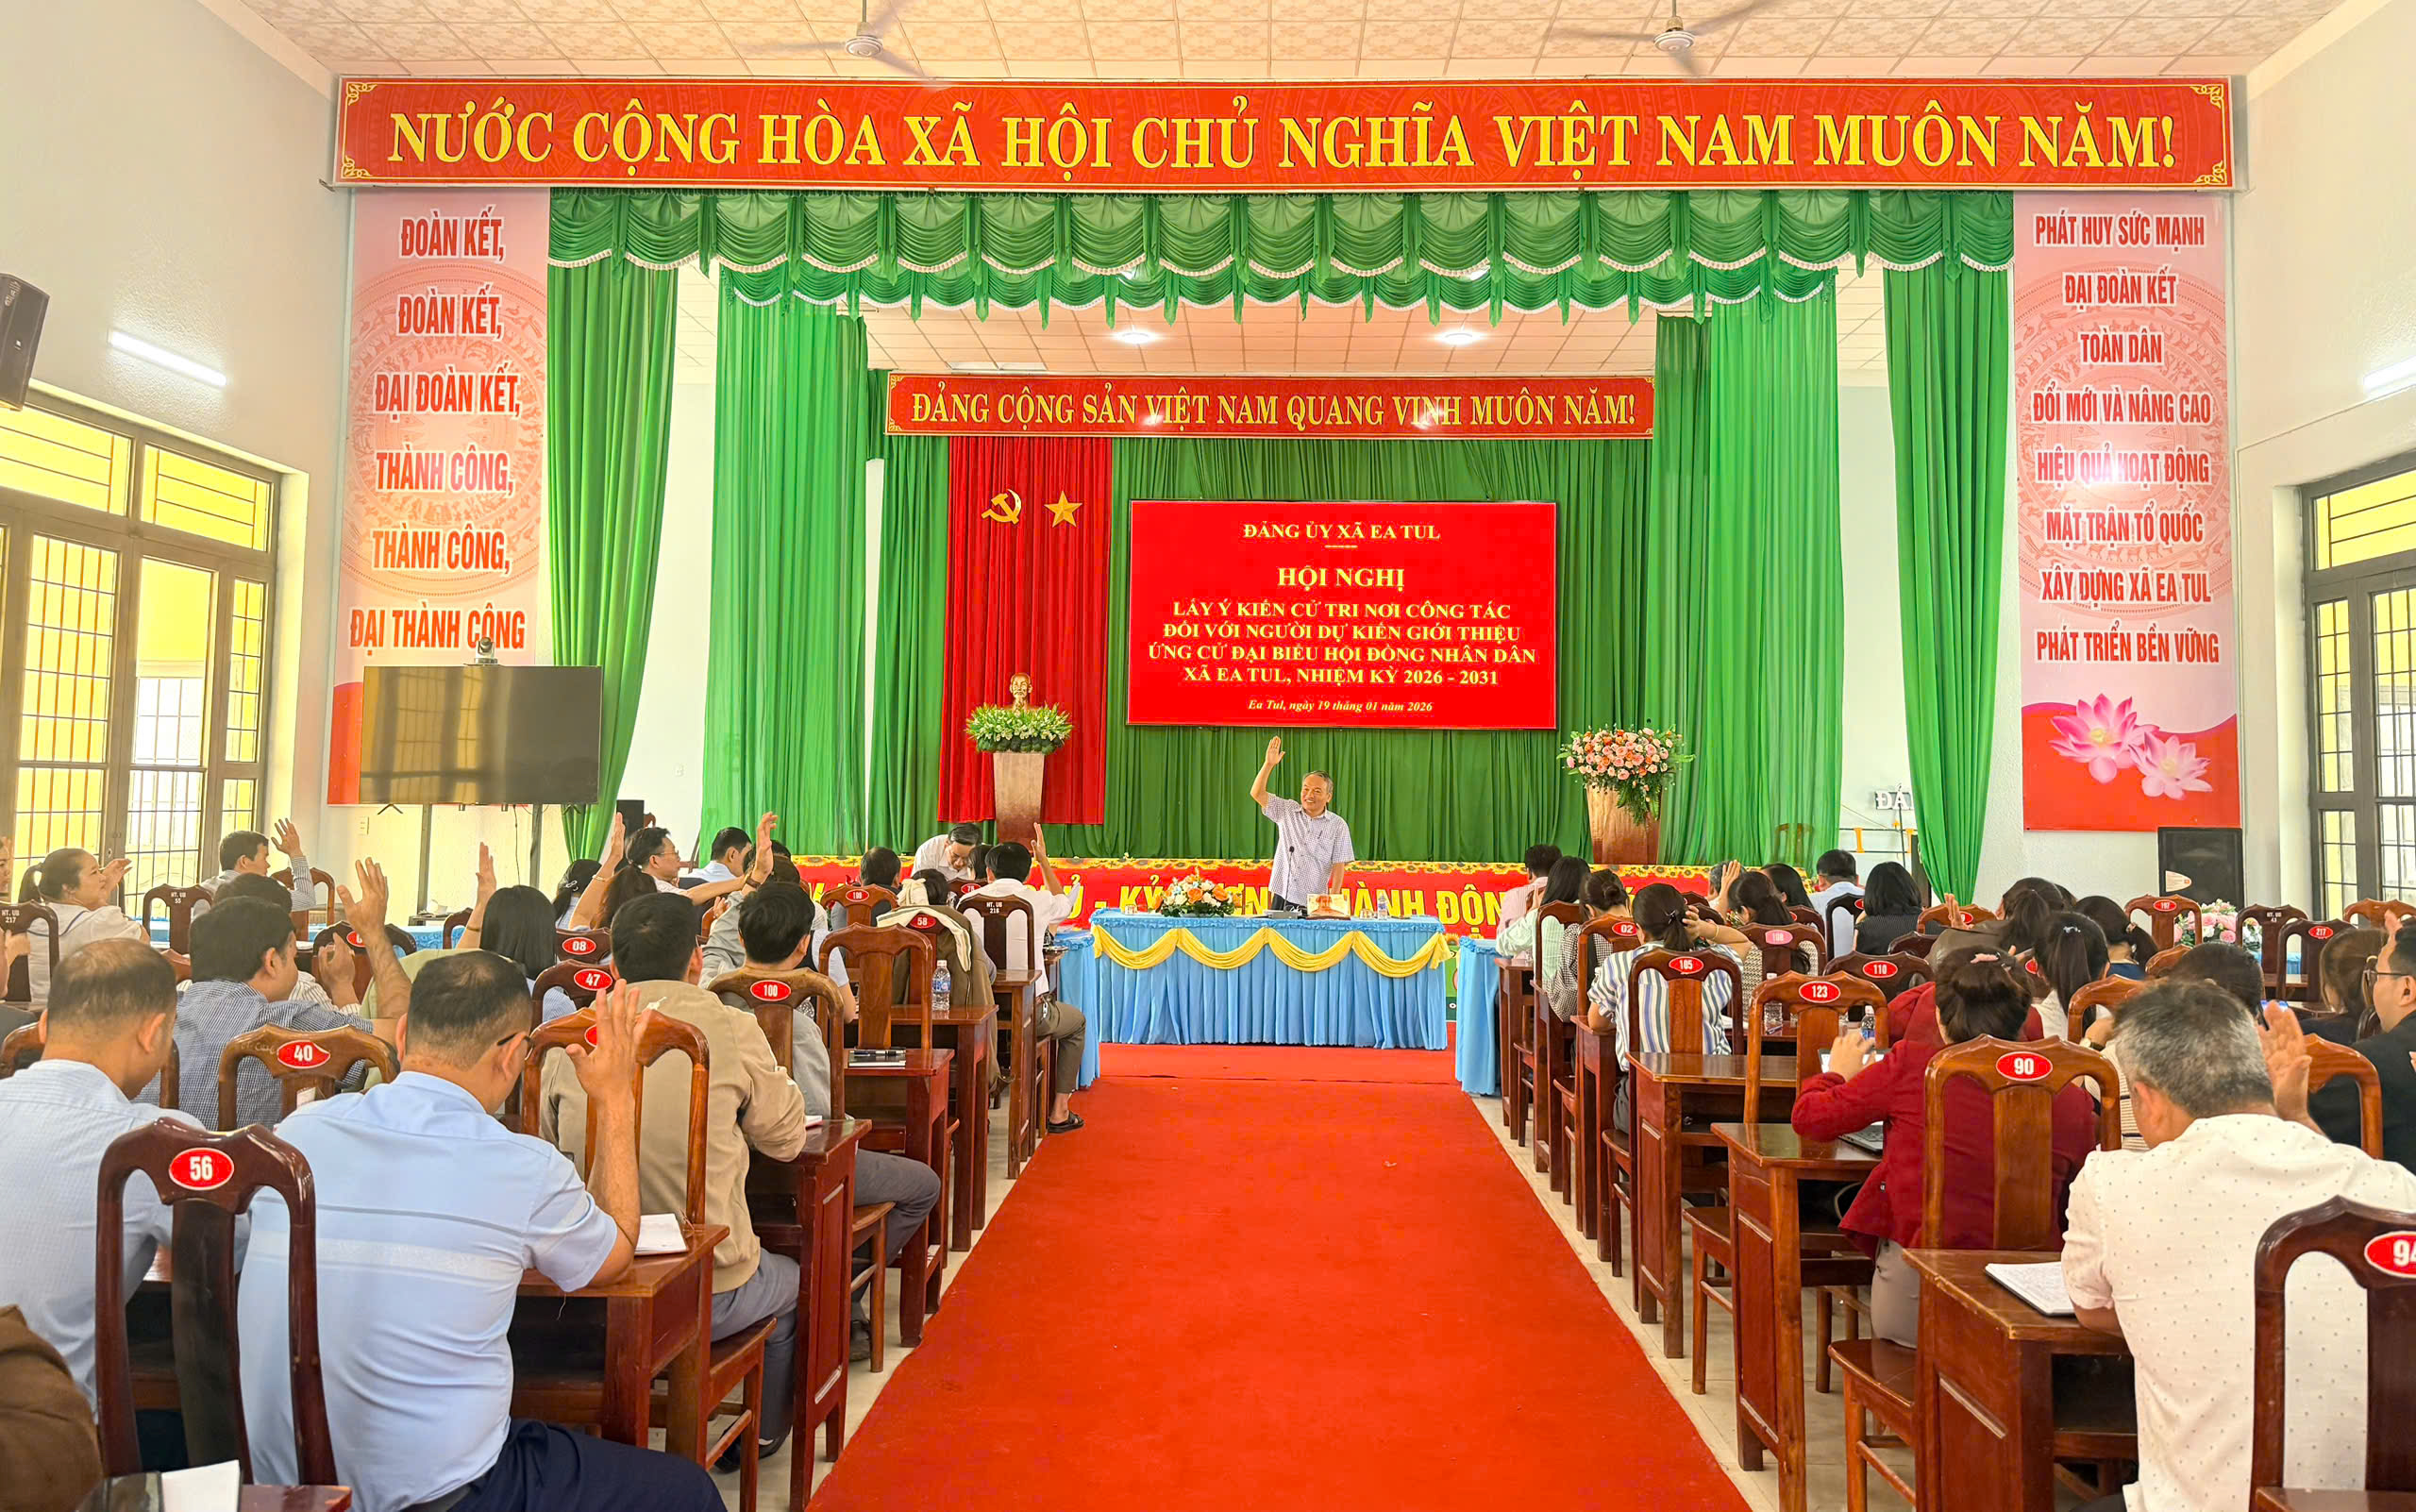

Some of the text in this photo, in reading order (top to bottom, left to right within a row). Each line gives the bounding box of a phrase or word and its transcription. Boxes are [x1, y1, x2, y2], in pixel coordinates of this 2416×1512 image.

[388, 94, 2176, 181] NƯỚC CỘNG HÒA XÃ HỘI CHỦ NGHĨA VIỆT NAM MUÔN NĂM!
[401, 205, 504, 260] ĐOÀN KẾT,
[2036, 209, 2205, 253] PHÁT HUY SỨC MẠNH
[2065, 262, 2176, 311] ĐẠI ĐOÀN KẾT
[398, 283, 502, 340] ĐOÀN KẾT,
[2080, 327, 2162, 364] TOÀN DÂN
[375, 361, 520, 421] ĐẠI ĐOÀN KẾT,
[2033, 379, 2211, 424] ĐỔI MỚI VÀ NÂNG CAO
[912, 381, 1637, 432] ĐẢNG CỘNG SẢN VIỆT NAM QUANG VINH MUÔN NĂM!
[377, 445, 513, 496] THÀNH CÔNG,
[2038, 443, 2209, 489] HIỆU QUẢ HOẠT ĐỘNG
[1244, 521, 1441, 540] ĐẢNG ỦY XÃ EA TUL
[2046, 500, 2204, 548] MẶT TRẬN TỔ QUỐC
[373, 525, 511, 576] THÀNH CÔNG,
[1278, 564, 1405, 593] HỘI NGHỊ
[2041, 564, 2211, 608] XÂY DỰNG XÃ EA TUL
[1173, 597, 1511, 619] LẤY Ý KIẾN CỬ TRI NƠI CÔNG TÁC
[350, 604, 526, 656] ĐẠI THÀNH CÔNG
[1164, 619, 1520, 645] ĐỐI VỚI NGƯỜI DỰ KIẾN GIỚI THIỆU
[2037, 620, 2220, 664] PHÁT TRIỂN BỀN VỮNG
[1149, 641, 1535, 665] ỨNG CỬ ĐẠI BIỂU HỘI ĐỒNG NHÂN DÂN
[1184, 664, 1212, 681] XÃ
[1216, 667, 1243, 681] EA
[1247, 667, 1292, 684] TUL,
[1297, 668, 1365, 687] NHIỆM
[1369, 664, 1398, 684] KỲ
[1403, 669, 1443, 684] 2026
[1459, 669, 1499, 685] 2031
[1249, 699, 1434, 713] Ea Tul, ngày 19 tháng 01 năm 2026
[917, 917, 928, 926] 58
[1436, 883, 1507, 933] ĐỘN
[1621, 926, 1634, 934] 02
[572, 941, 587, 952] 08
[584, 972, 600, 986] 47
[1680, 959, 1693, 970] 105
[1873, 964, 1888, 975] 110
[763, 983, 779, 997] 100
[1811, 985, 1828, 999] 123
[294, 1045, 313, 1062] 40
[2013, 1058, 2035, 1075] 90
[189, 1155, 213, 1181] 56
